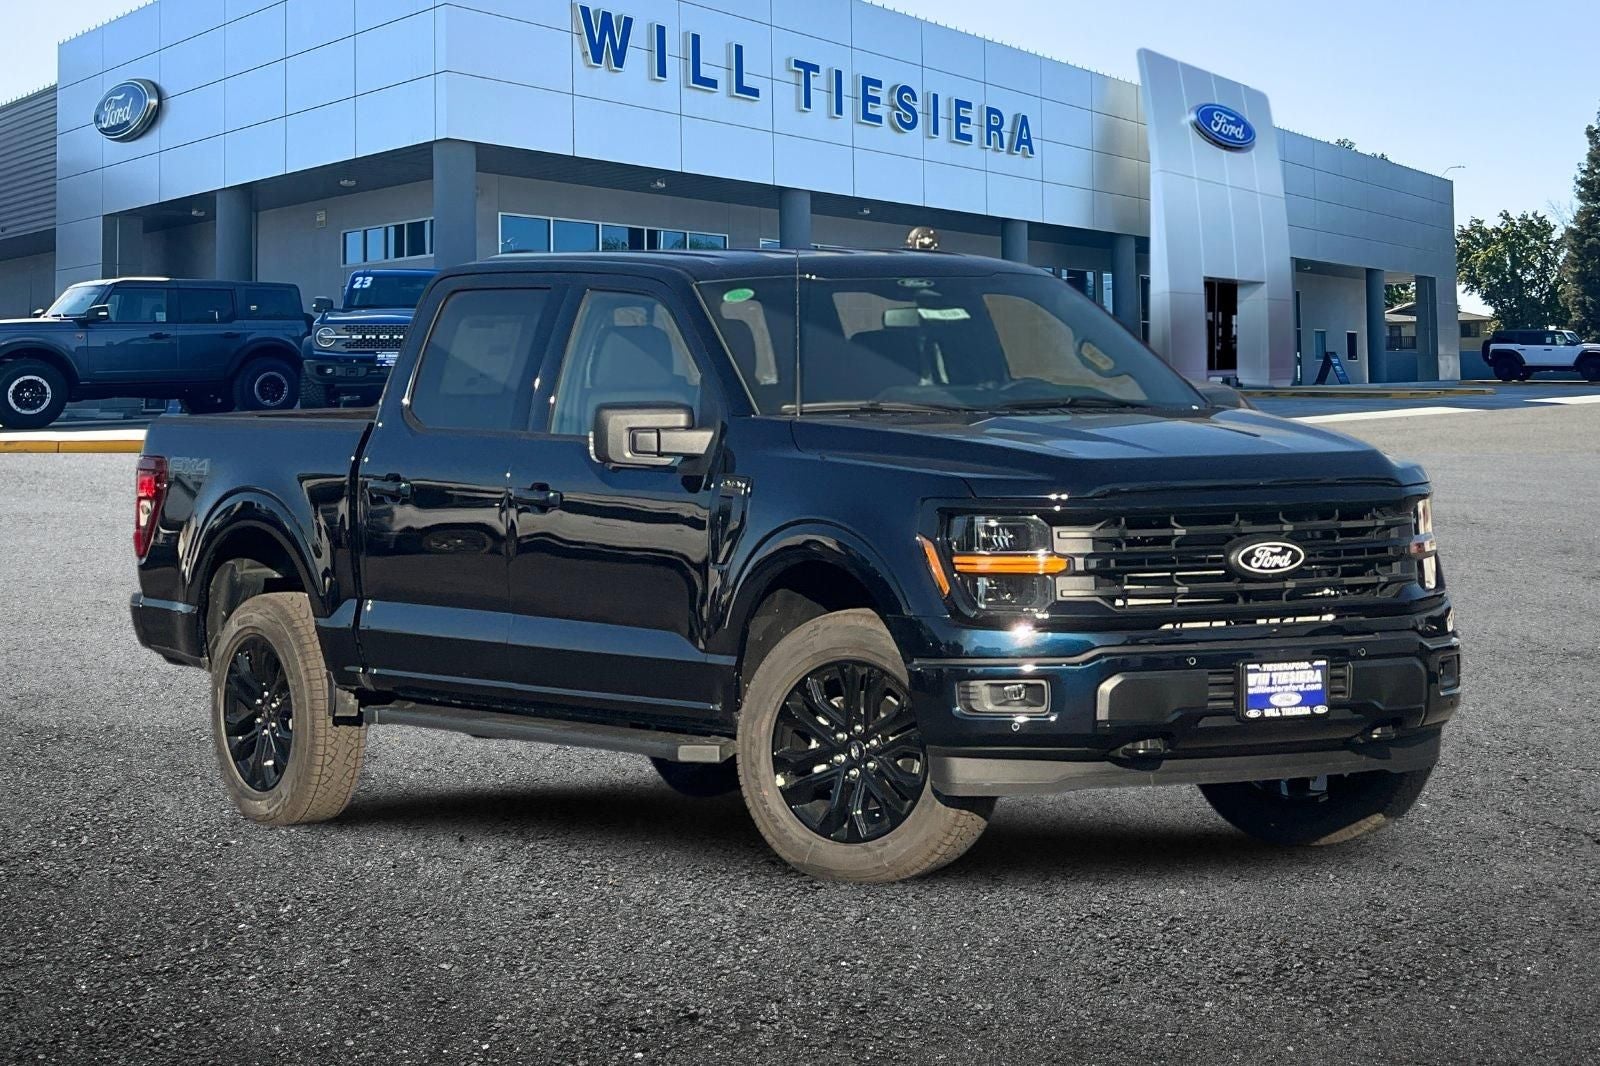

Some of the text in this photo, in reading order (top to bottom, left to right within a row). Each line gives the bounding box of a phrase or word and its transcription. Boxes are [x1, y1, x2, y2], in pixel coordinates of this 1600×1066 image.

[576, 3, 1036, 158] WILL TIESIERA
[101, 93, 133, 128] Ford
[1211, 111, 1245, 139] Ford
[353, 276, 374, 289] 23
[169, 456, 211, 480] FX4
[1251, 547, 1293, 568] Ford
[1272, 669, 1322, 685] TIESIERA
[1264, 708, 1280, 717] WILL
